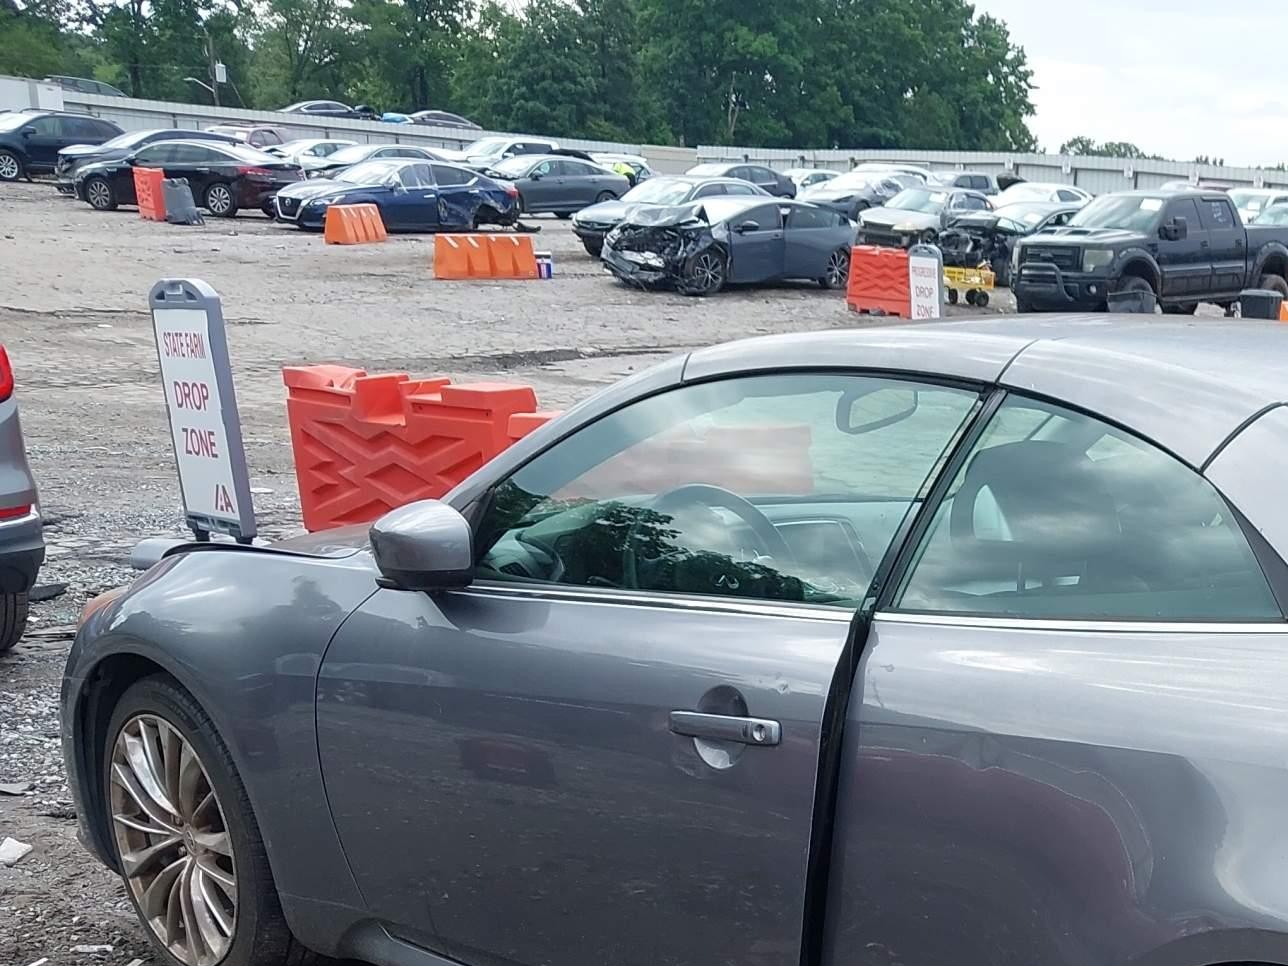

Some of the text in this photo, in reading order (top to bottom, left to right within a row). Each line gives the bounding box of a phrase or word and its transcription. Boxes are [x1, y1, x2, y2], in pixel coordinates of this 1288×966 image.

[915, 285, 934, 298] DROP
[163, 331, 207, 360] STATE FARM
[173, 381, 209, 412] DROP
[181, 427, 219, 459] ZONE
